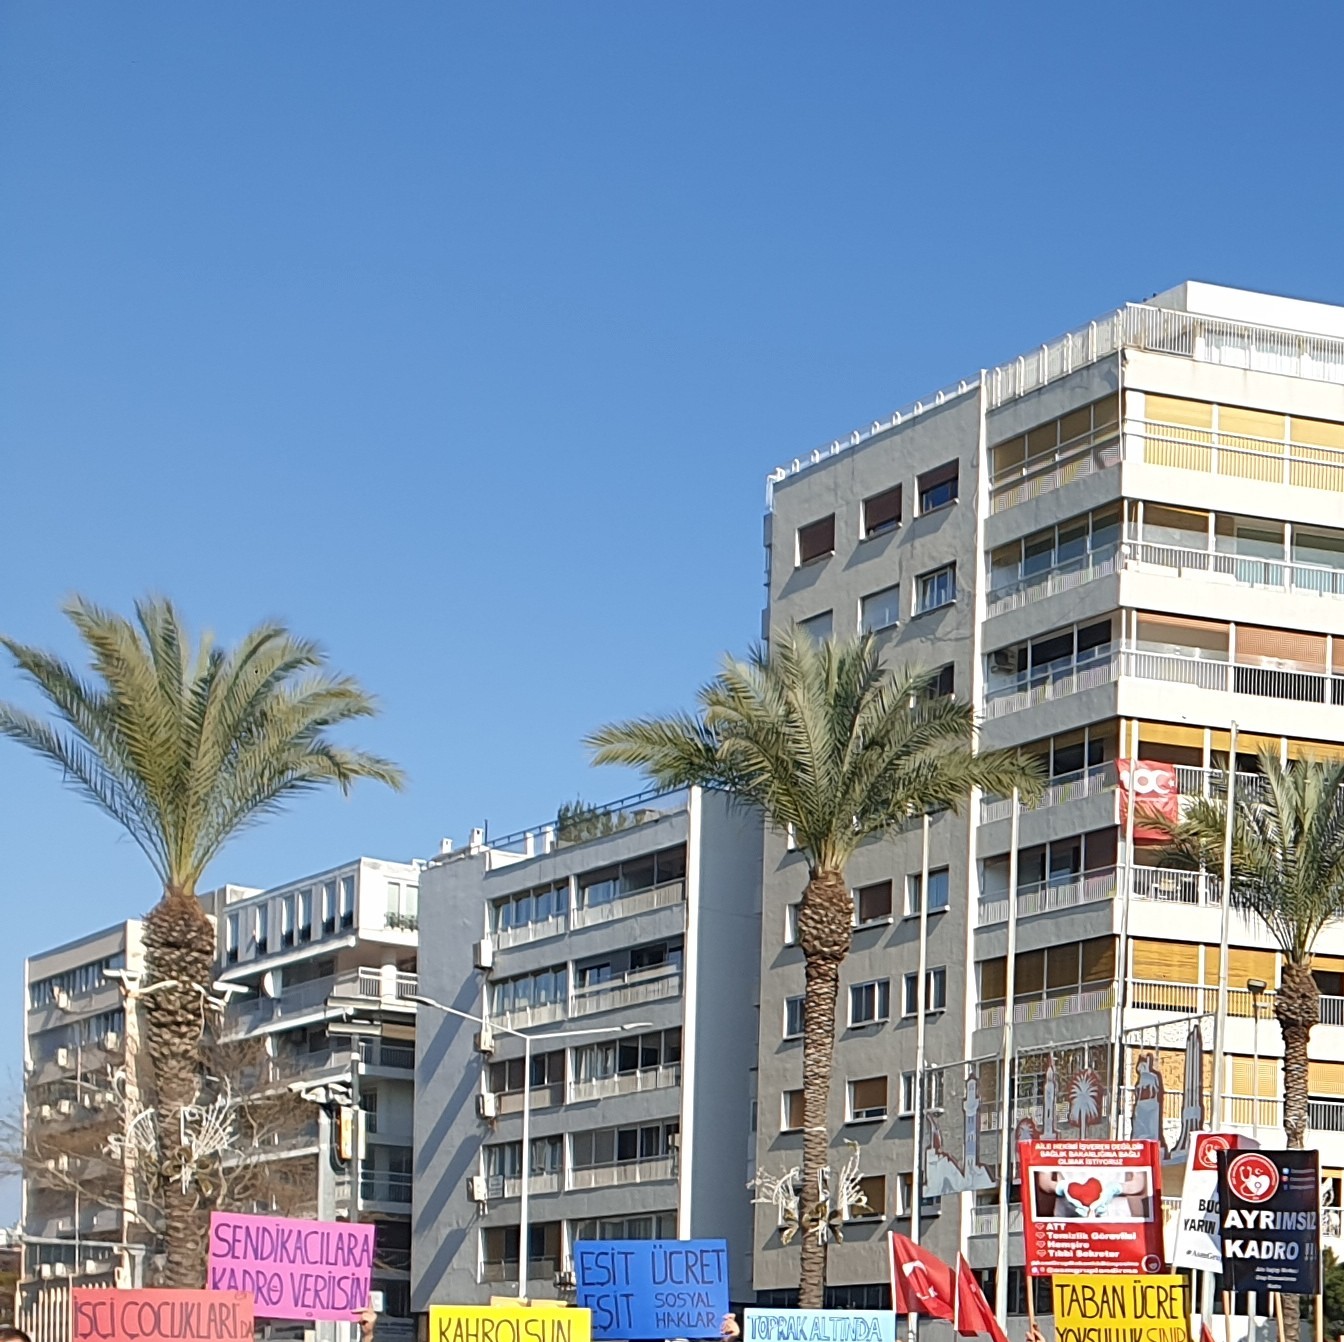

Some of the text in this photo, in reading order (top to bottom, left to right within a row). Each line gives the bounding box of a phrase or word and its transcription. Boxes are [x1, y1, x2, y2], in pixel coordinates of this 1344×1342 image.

[1224, 1209, 1317, 1231] AYRIMSIZ
[213, 1222, 374, 1268] SENDİKACILARA
[1224, 1239, 1300, 1261] KADRO
[580, 1244, 726, 1287] EŞİT ÜCRET
[211, 1266, 284, 1306] KADRO
[654, 1292, 716, 1308] SOSYAL
[1056, 1284, 1127, 1319] TABAN
[656, 1311, 718, 1328] HAKLAR
[747, 1315, 883, 1342] TOPRAK ALTINDA
